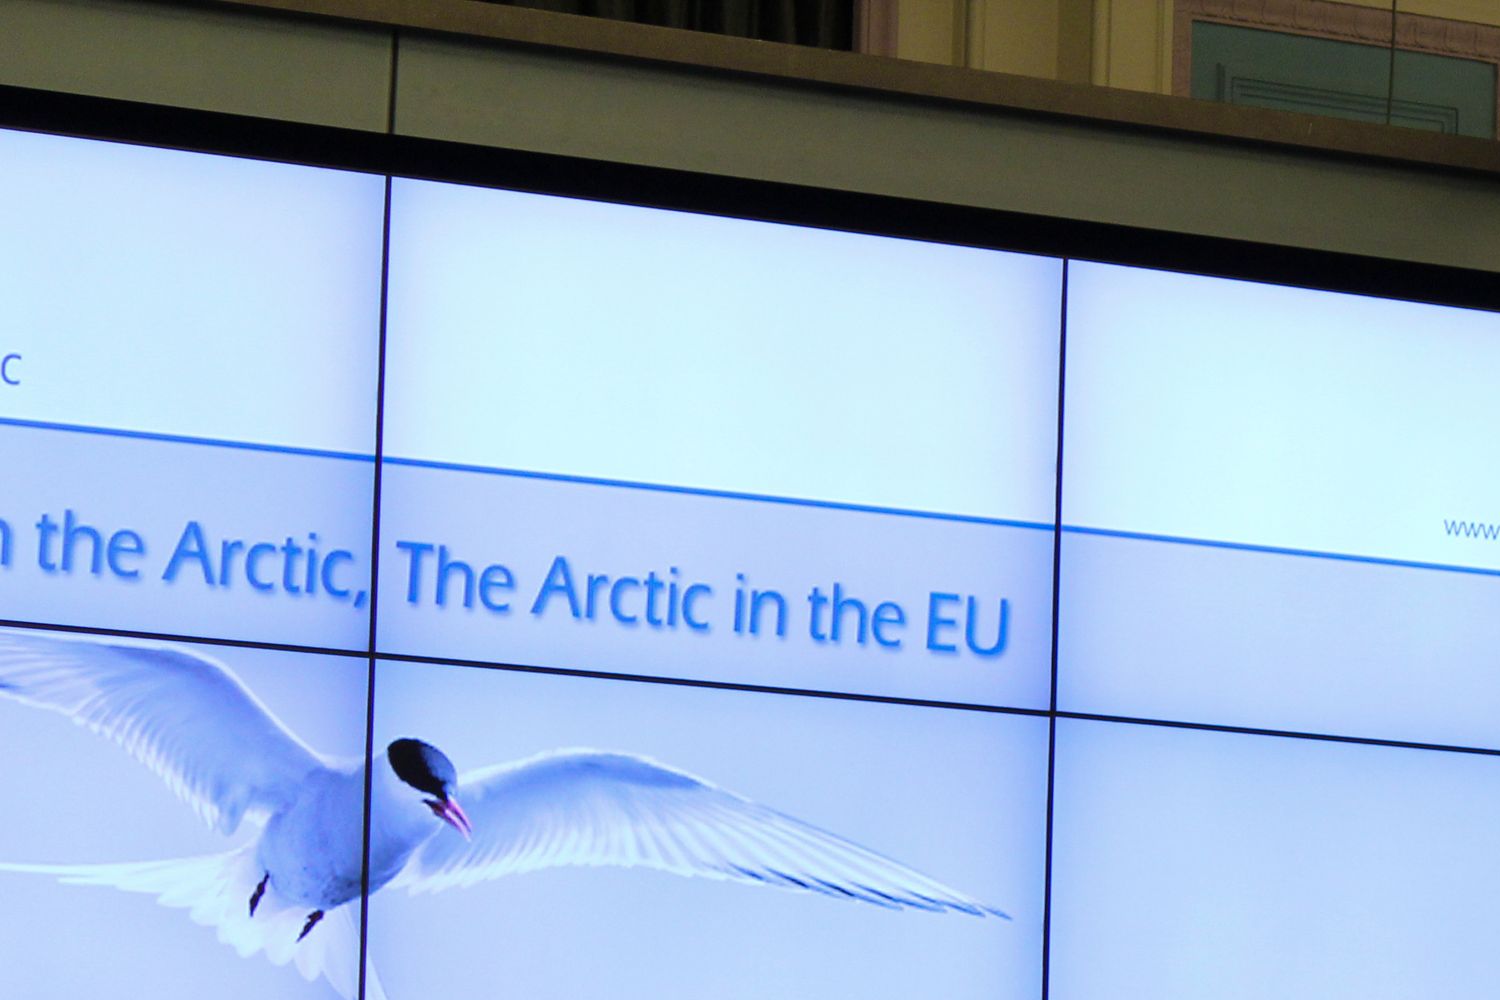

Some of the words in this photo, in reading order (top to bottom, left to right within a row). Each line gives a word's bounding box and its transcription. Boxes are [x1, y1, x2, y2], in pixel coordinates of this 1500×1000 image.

[35, 509, 147, 578] the
[161, 520, 367, 609] Arctic,
[396, 540, 514, 613] The
[529, 555, 712, 630] Arctic
[733, 573, 785, 637] in
[807, 582, 905, 647] the
[926, 591, 1009, 656] EU
